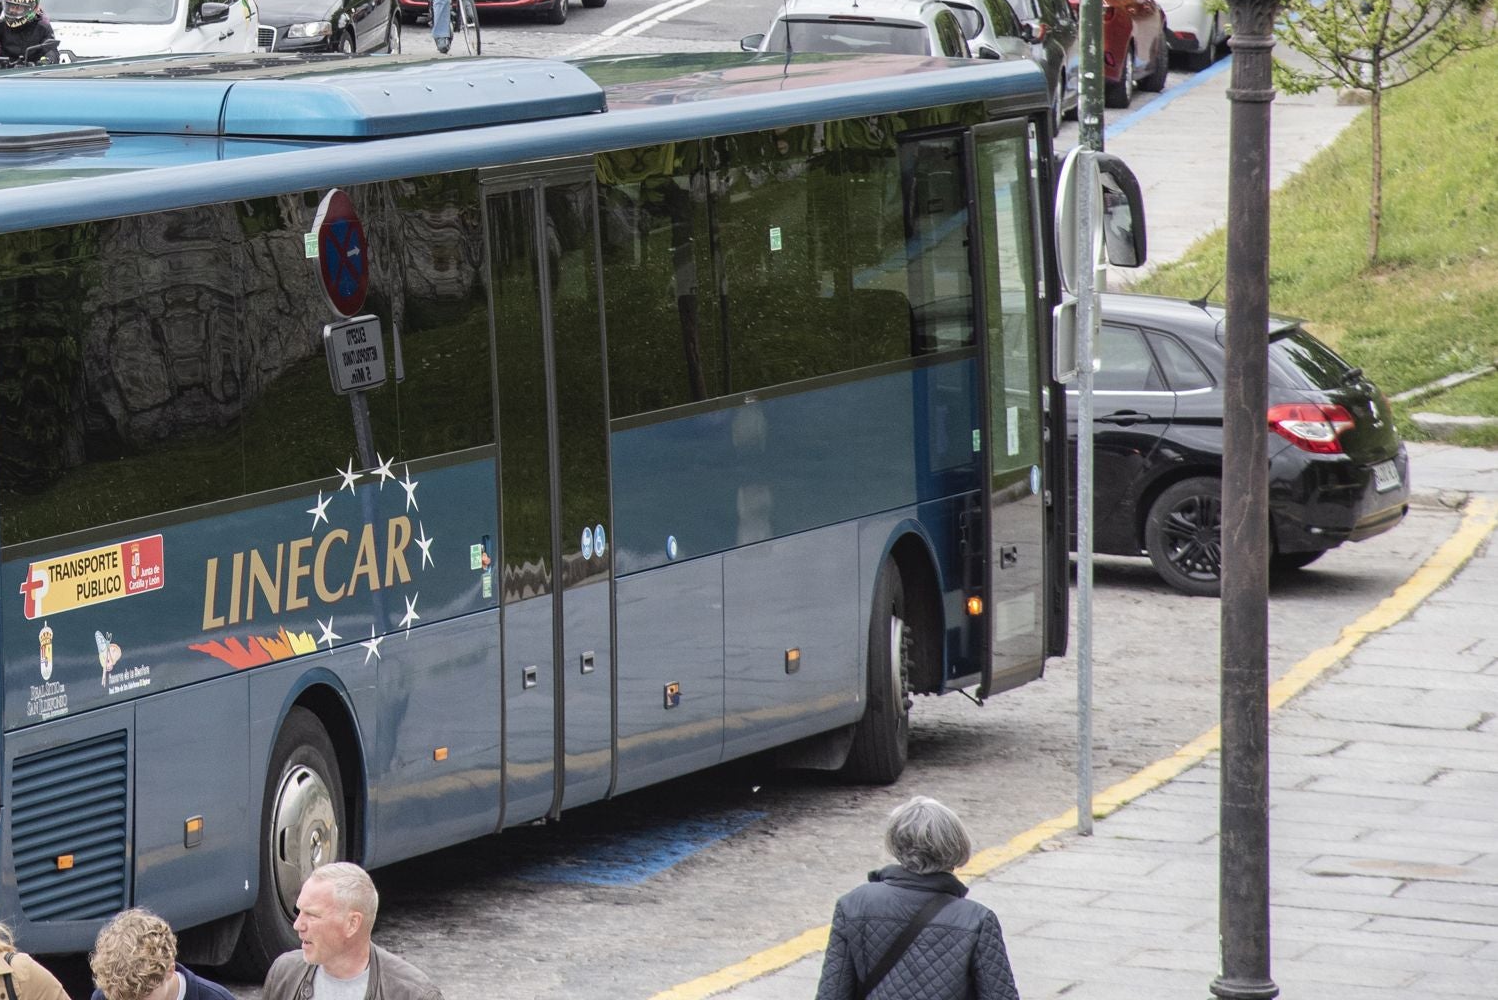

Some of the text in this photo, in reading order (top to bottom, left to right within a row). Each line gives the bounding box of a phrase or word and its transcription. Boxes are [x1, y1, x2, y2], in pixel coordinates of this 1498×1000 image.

[48, 551, 118, 583] TRANSPORTE
[140, 564, 160, 578] Junta de
[202, 515, 412, 631] LINECAR
[76, 575, 121, 601] PÚBLICO
[144, 580, 149, 589] y
[149, 576, 160, 586] León
